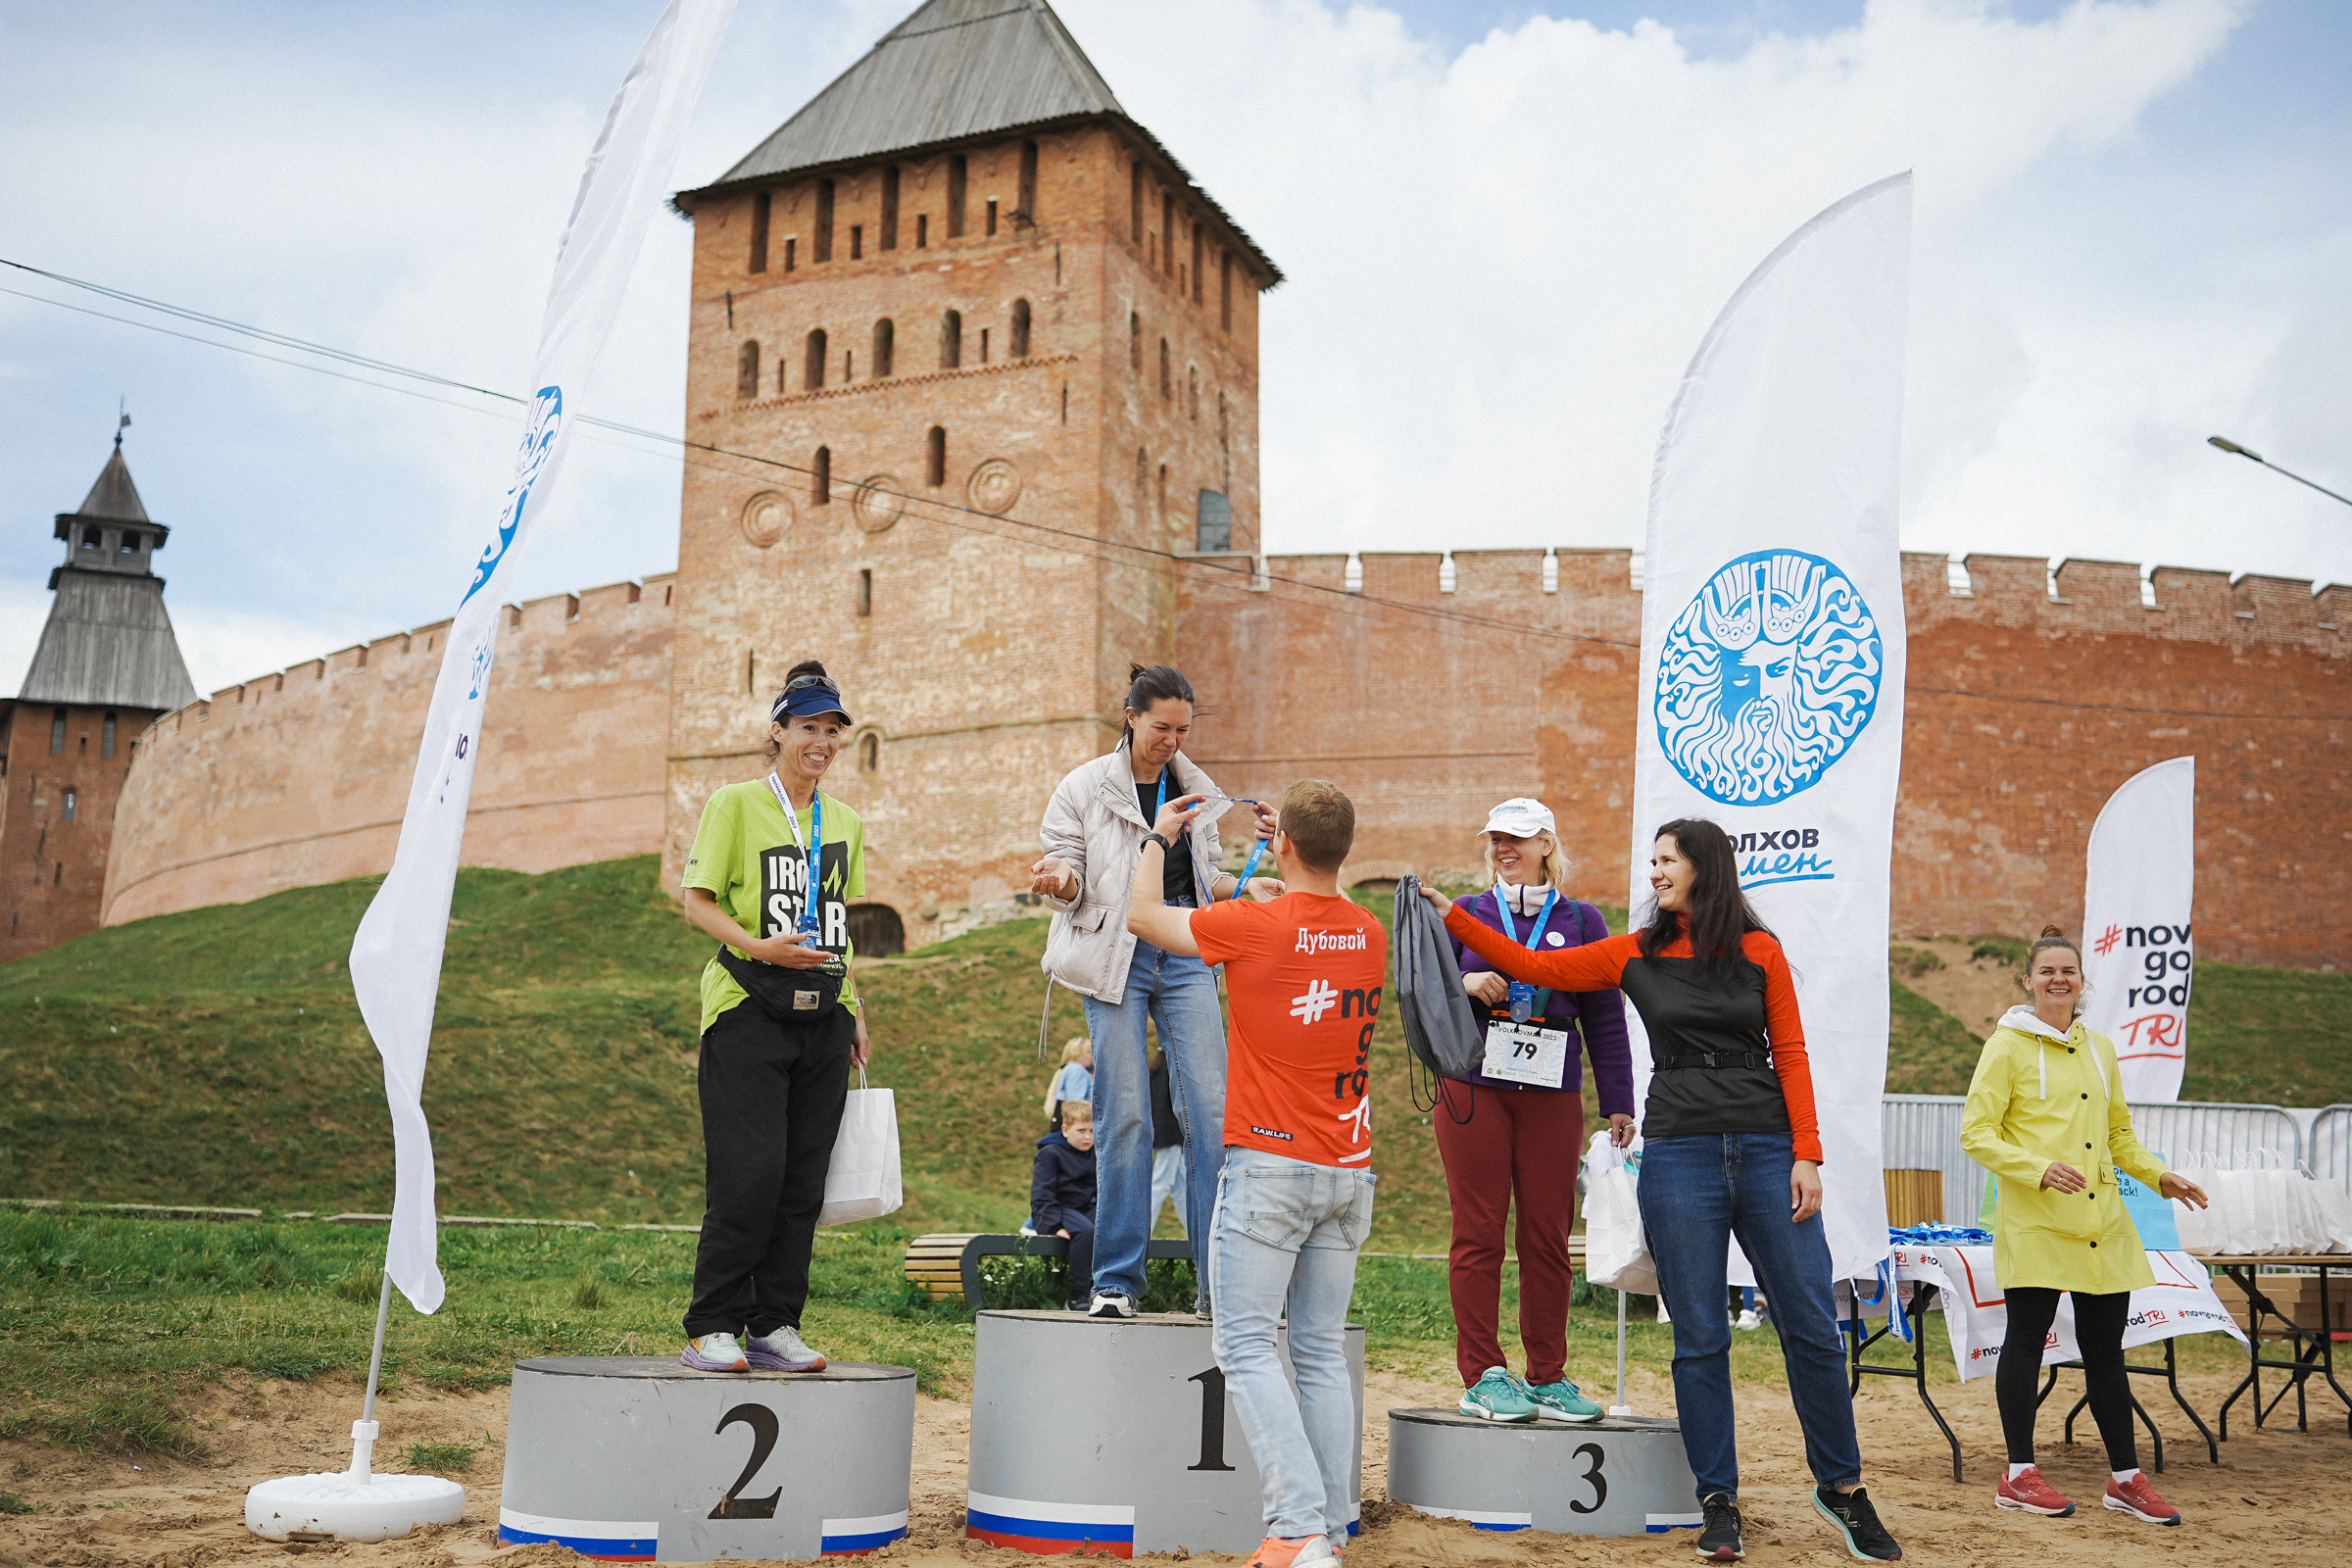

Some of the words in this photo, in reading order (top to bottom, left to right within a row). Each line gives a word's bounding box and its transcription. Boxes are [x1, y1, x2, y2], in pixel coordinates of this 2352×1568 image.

[768, 856, 809, 894] IRO
[1740, 852, 1833, 877] мен
[1295, 927, 1367, 956] Дубовой
[2093, 923, 2191, 956] #nov
[2144, 950, 2191, 981] go
[1290, 979, 1382, 1026] #no
[2129, 973, 2189, 1008] rod
[1356, 1022, 1376, 1066] g
[1543, 1033, 1557, 1042] 2023
[2120, 1013, 2183, 1047] TRI
[1512, 1041, 1538, 1060] 79
[1335, 1067, 1369, 1100] ro
[2119, 1186, 2138, 1197] ack!
[1186, 1365, 1236, 1472] 1
[707, 1402, 783, 1520] 2
[1569, 1443, 1607, 1514] 3
